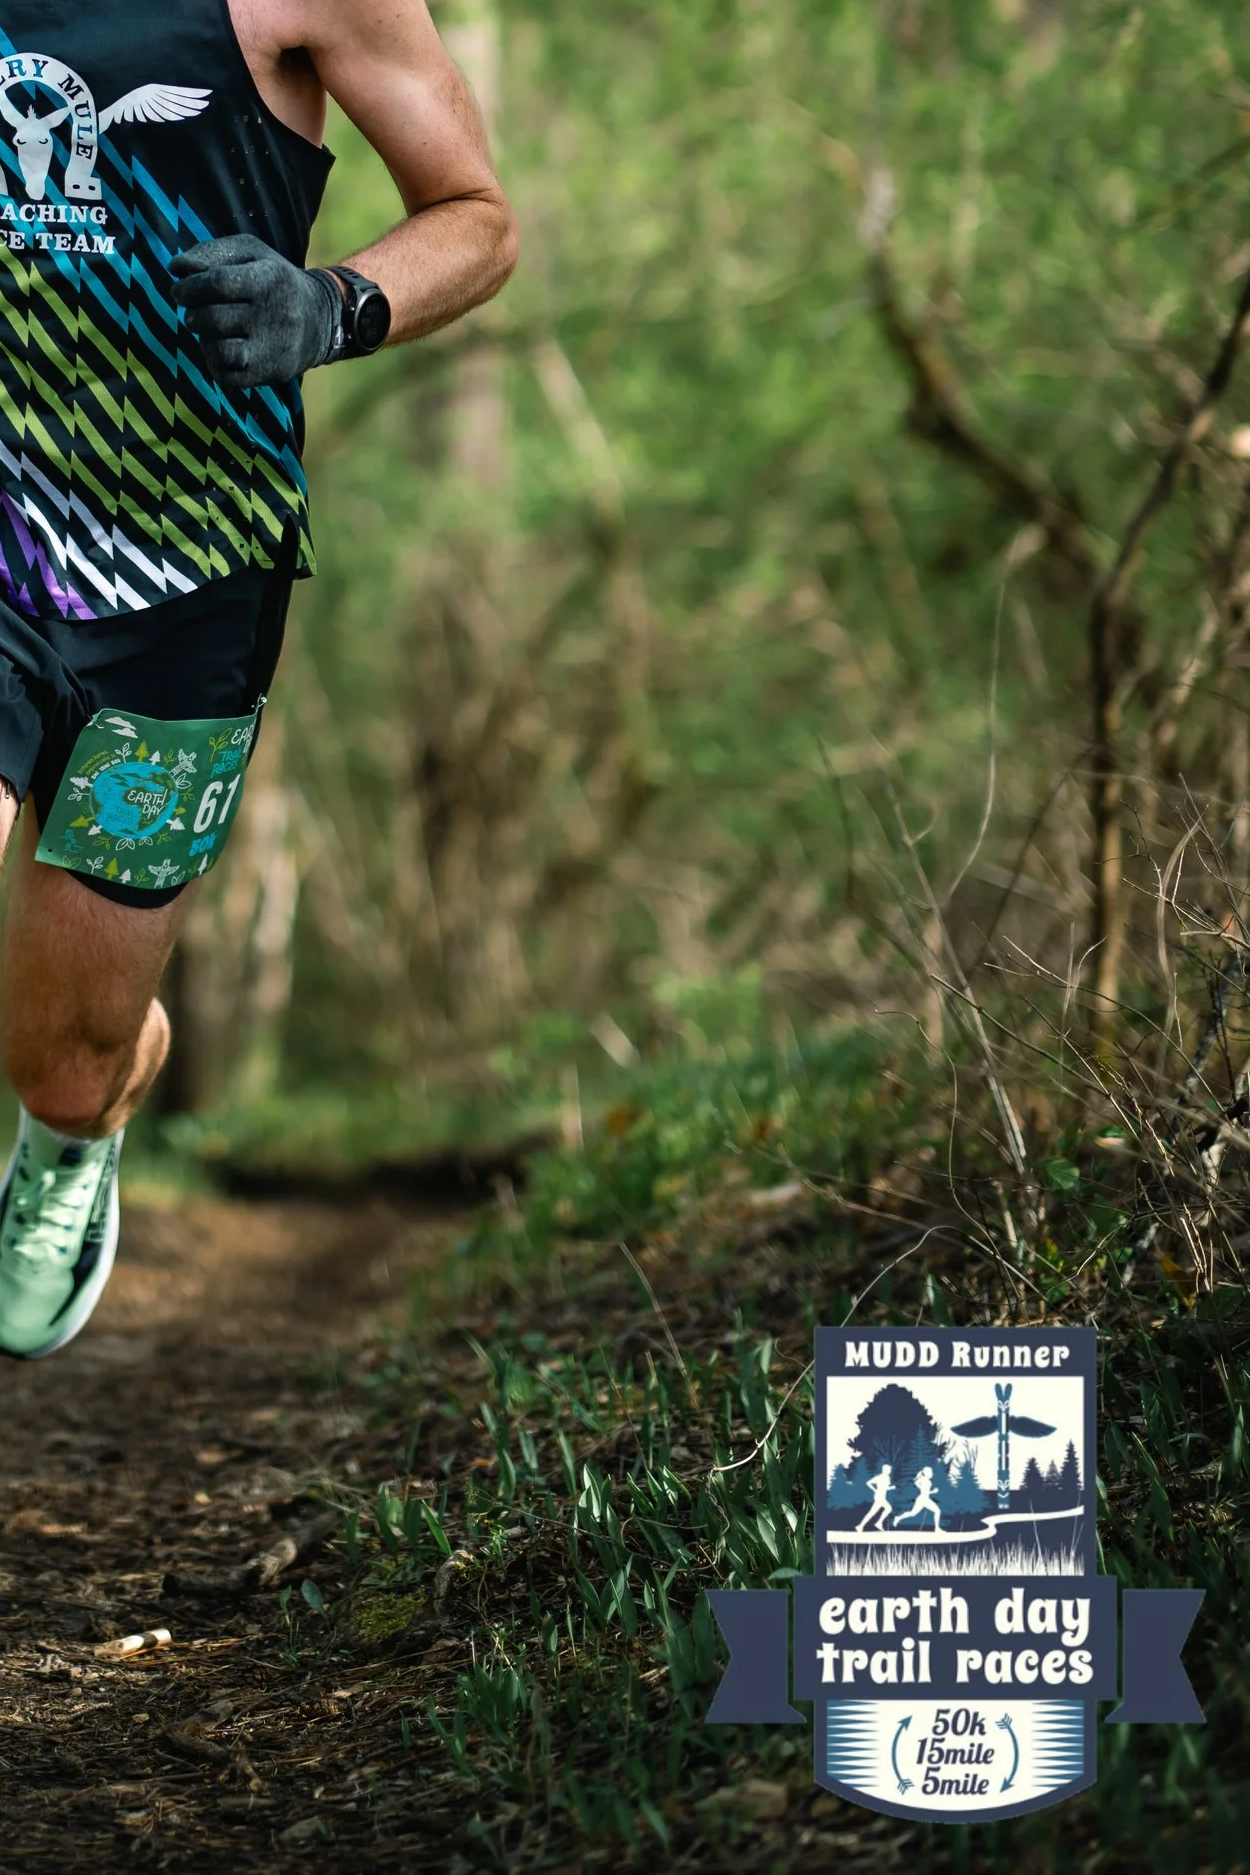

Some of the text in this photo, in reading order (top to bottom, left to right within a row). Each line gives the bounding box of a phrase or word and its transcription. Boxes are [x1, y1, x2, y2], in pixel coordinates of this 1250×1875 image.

[57, 73, 94, 161] MULE
[36, 232, 116, 255] TEAM
[231, 724, 255, 745] EAR
[127, 789, 168, 805] EARTH
[193, 773, 241, 833] 61
[142, 804, 165, 820] DAY
